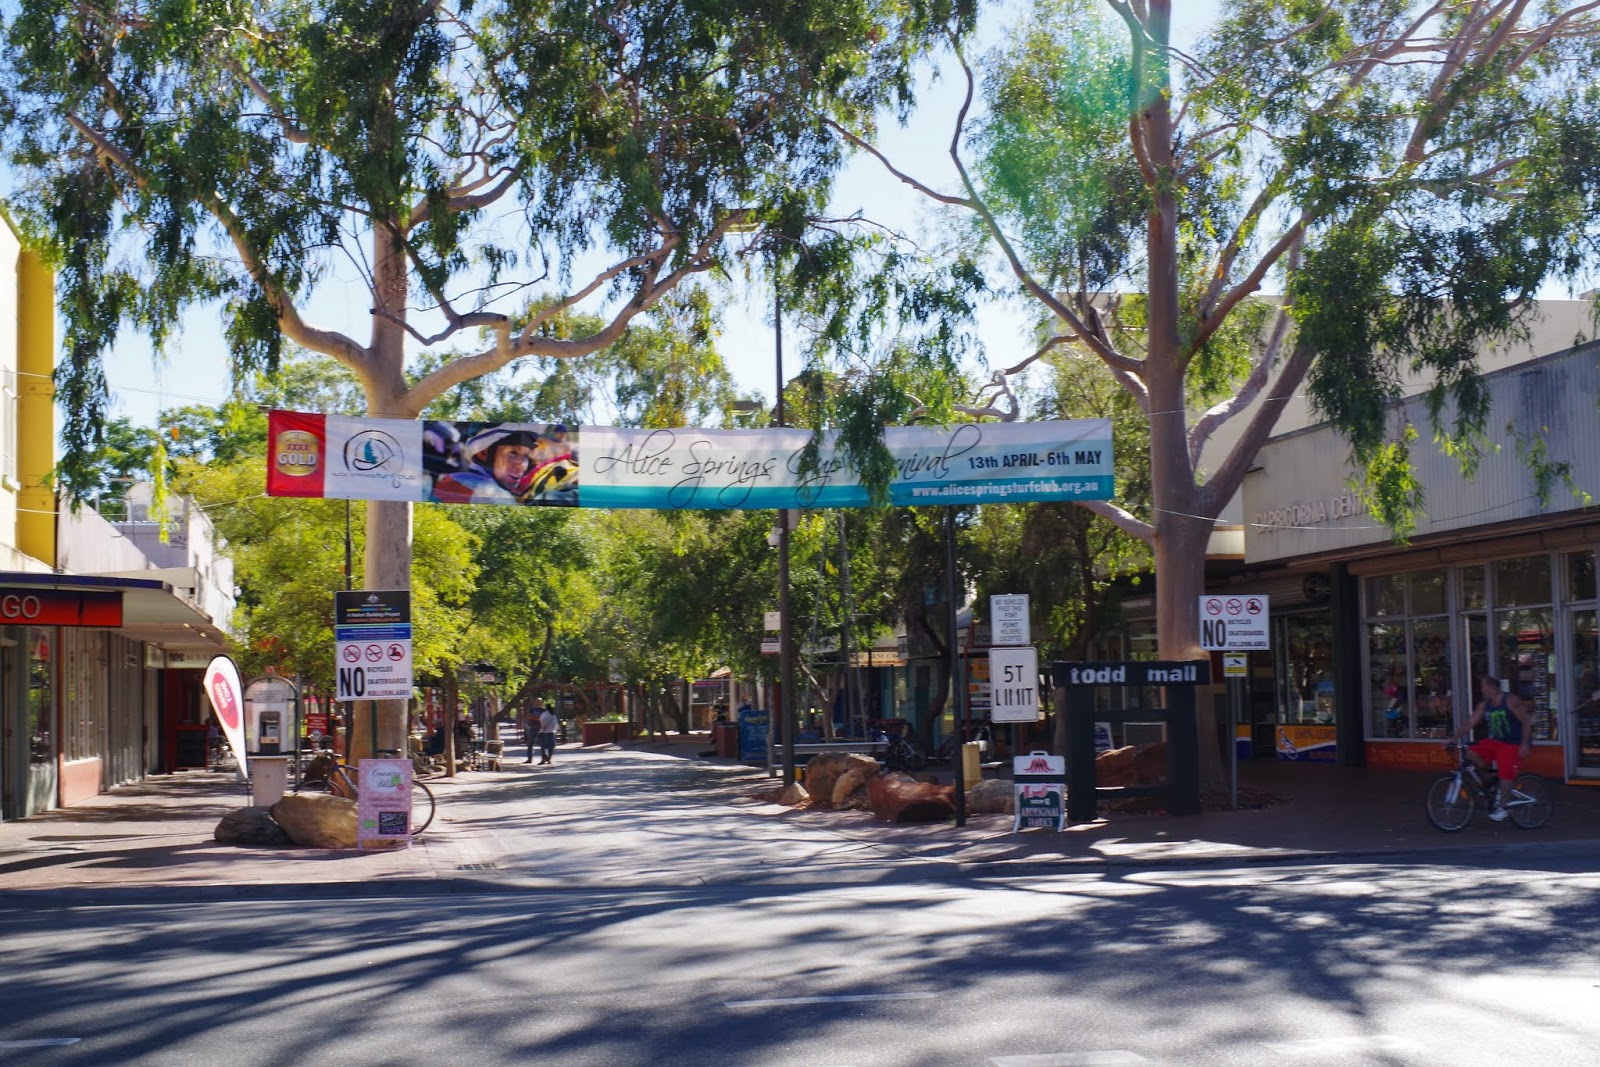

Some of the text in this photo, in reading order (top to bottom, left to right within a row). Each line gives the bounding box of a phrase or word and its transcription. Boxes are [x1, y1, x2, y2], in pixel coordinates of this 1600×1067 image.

[278, 453, 316, 465] GOLD
[594, 430, 675, 474] Alice
[667, 441, 776, 507] Springs
[968, 455, 998, 468] 13th
[1075, 450, 1101, 464] MAY
[912, 481, 1098, 497] www.alicespringsturfclub.org.au
[1203, 619, 1226, 647] NO
[340, 667, 365, 697] NO
[1071, 665, 1197, 684] todd mall
